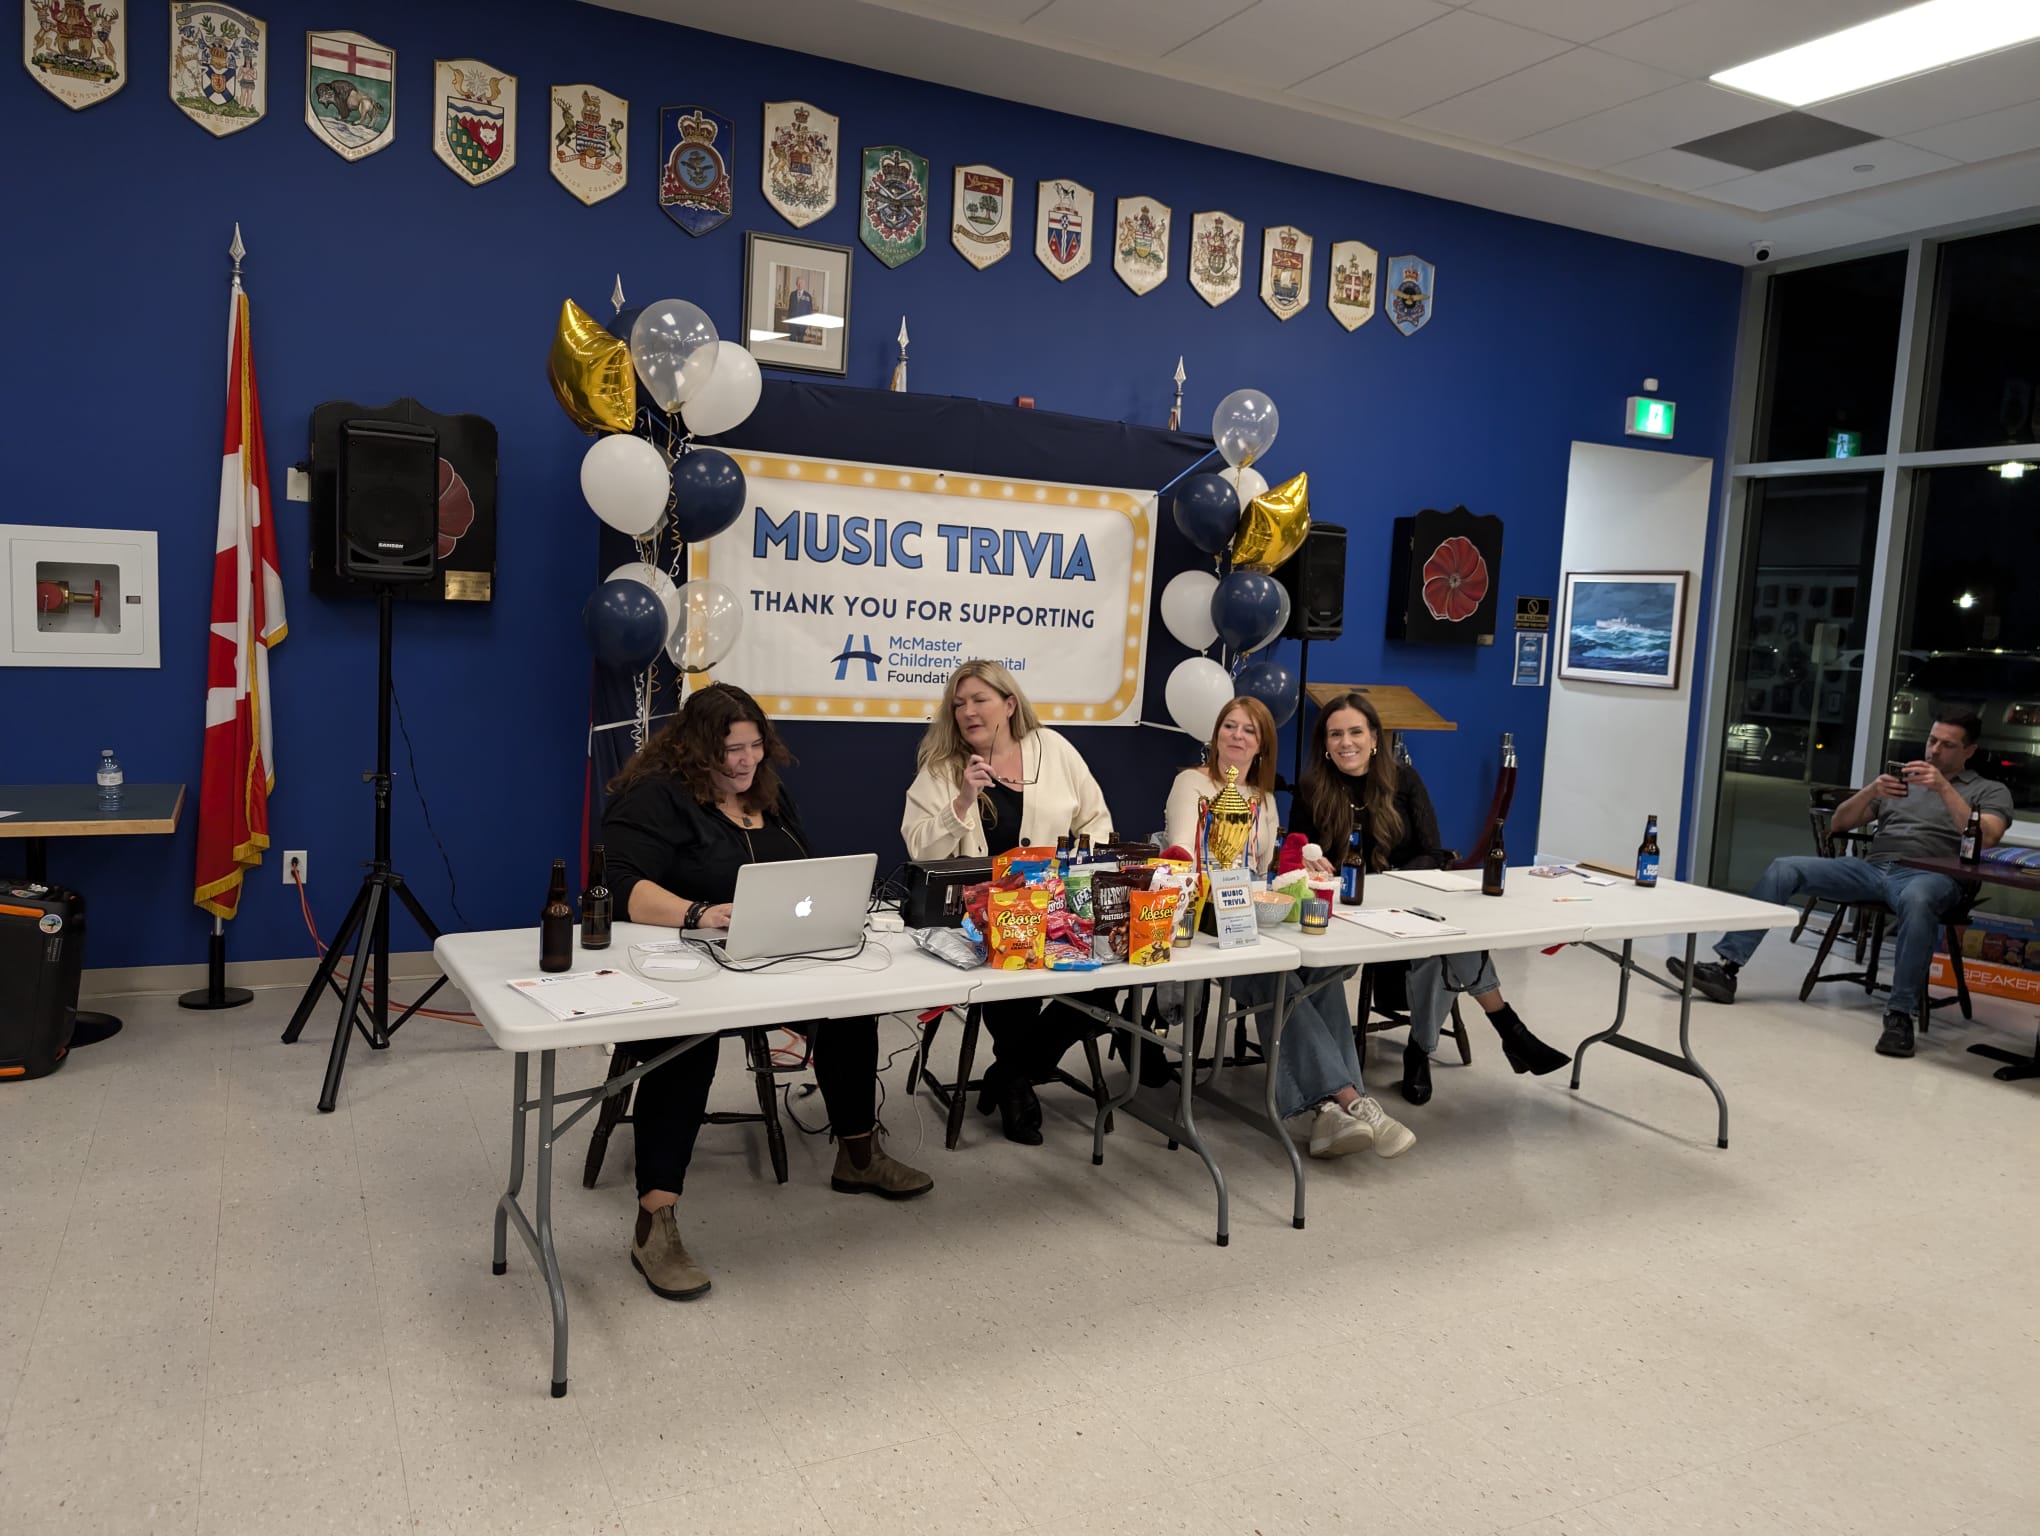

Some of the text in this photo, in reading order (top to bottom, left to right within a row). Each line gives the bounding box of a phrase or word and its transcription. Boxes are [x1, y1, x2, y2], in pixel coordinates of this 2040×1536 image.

[753, 506, 1097, 582] MUSIC TRIVIA
[750, 589, 1095, 629] THANK YOU FOR SUPPORTING
[889, 635, 962, 653] McMaster
[888, 652, 962, 669] Children's
[887, 670, 950, 684] Foundati
[1221, 889, 1244, 898] MUSIC
[1222, 898, 1247, 907] TRIVIA
[996, 909, 1043, 927] Reese's
[1139, 904, 1175, 921] Reese's
[1002, 926, 1039, 940] pieces
